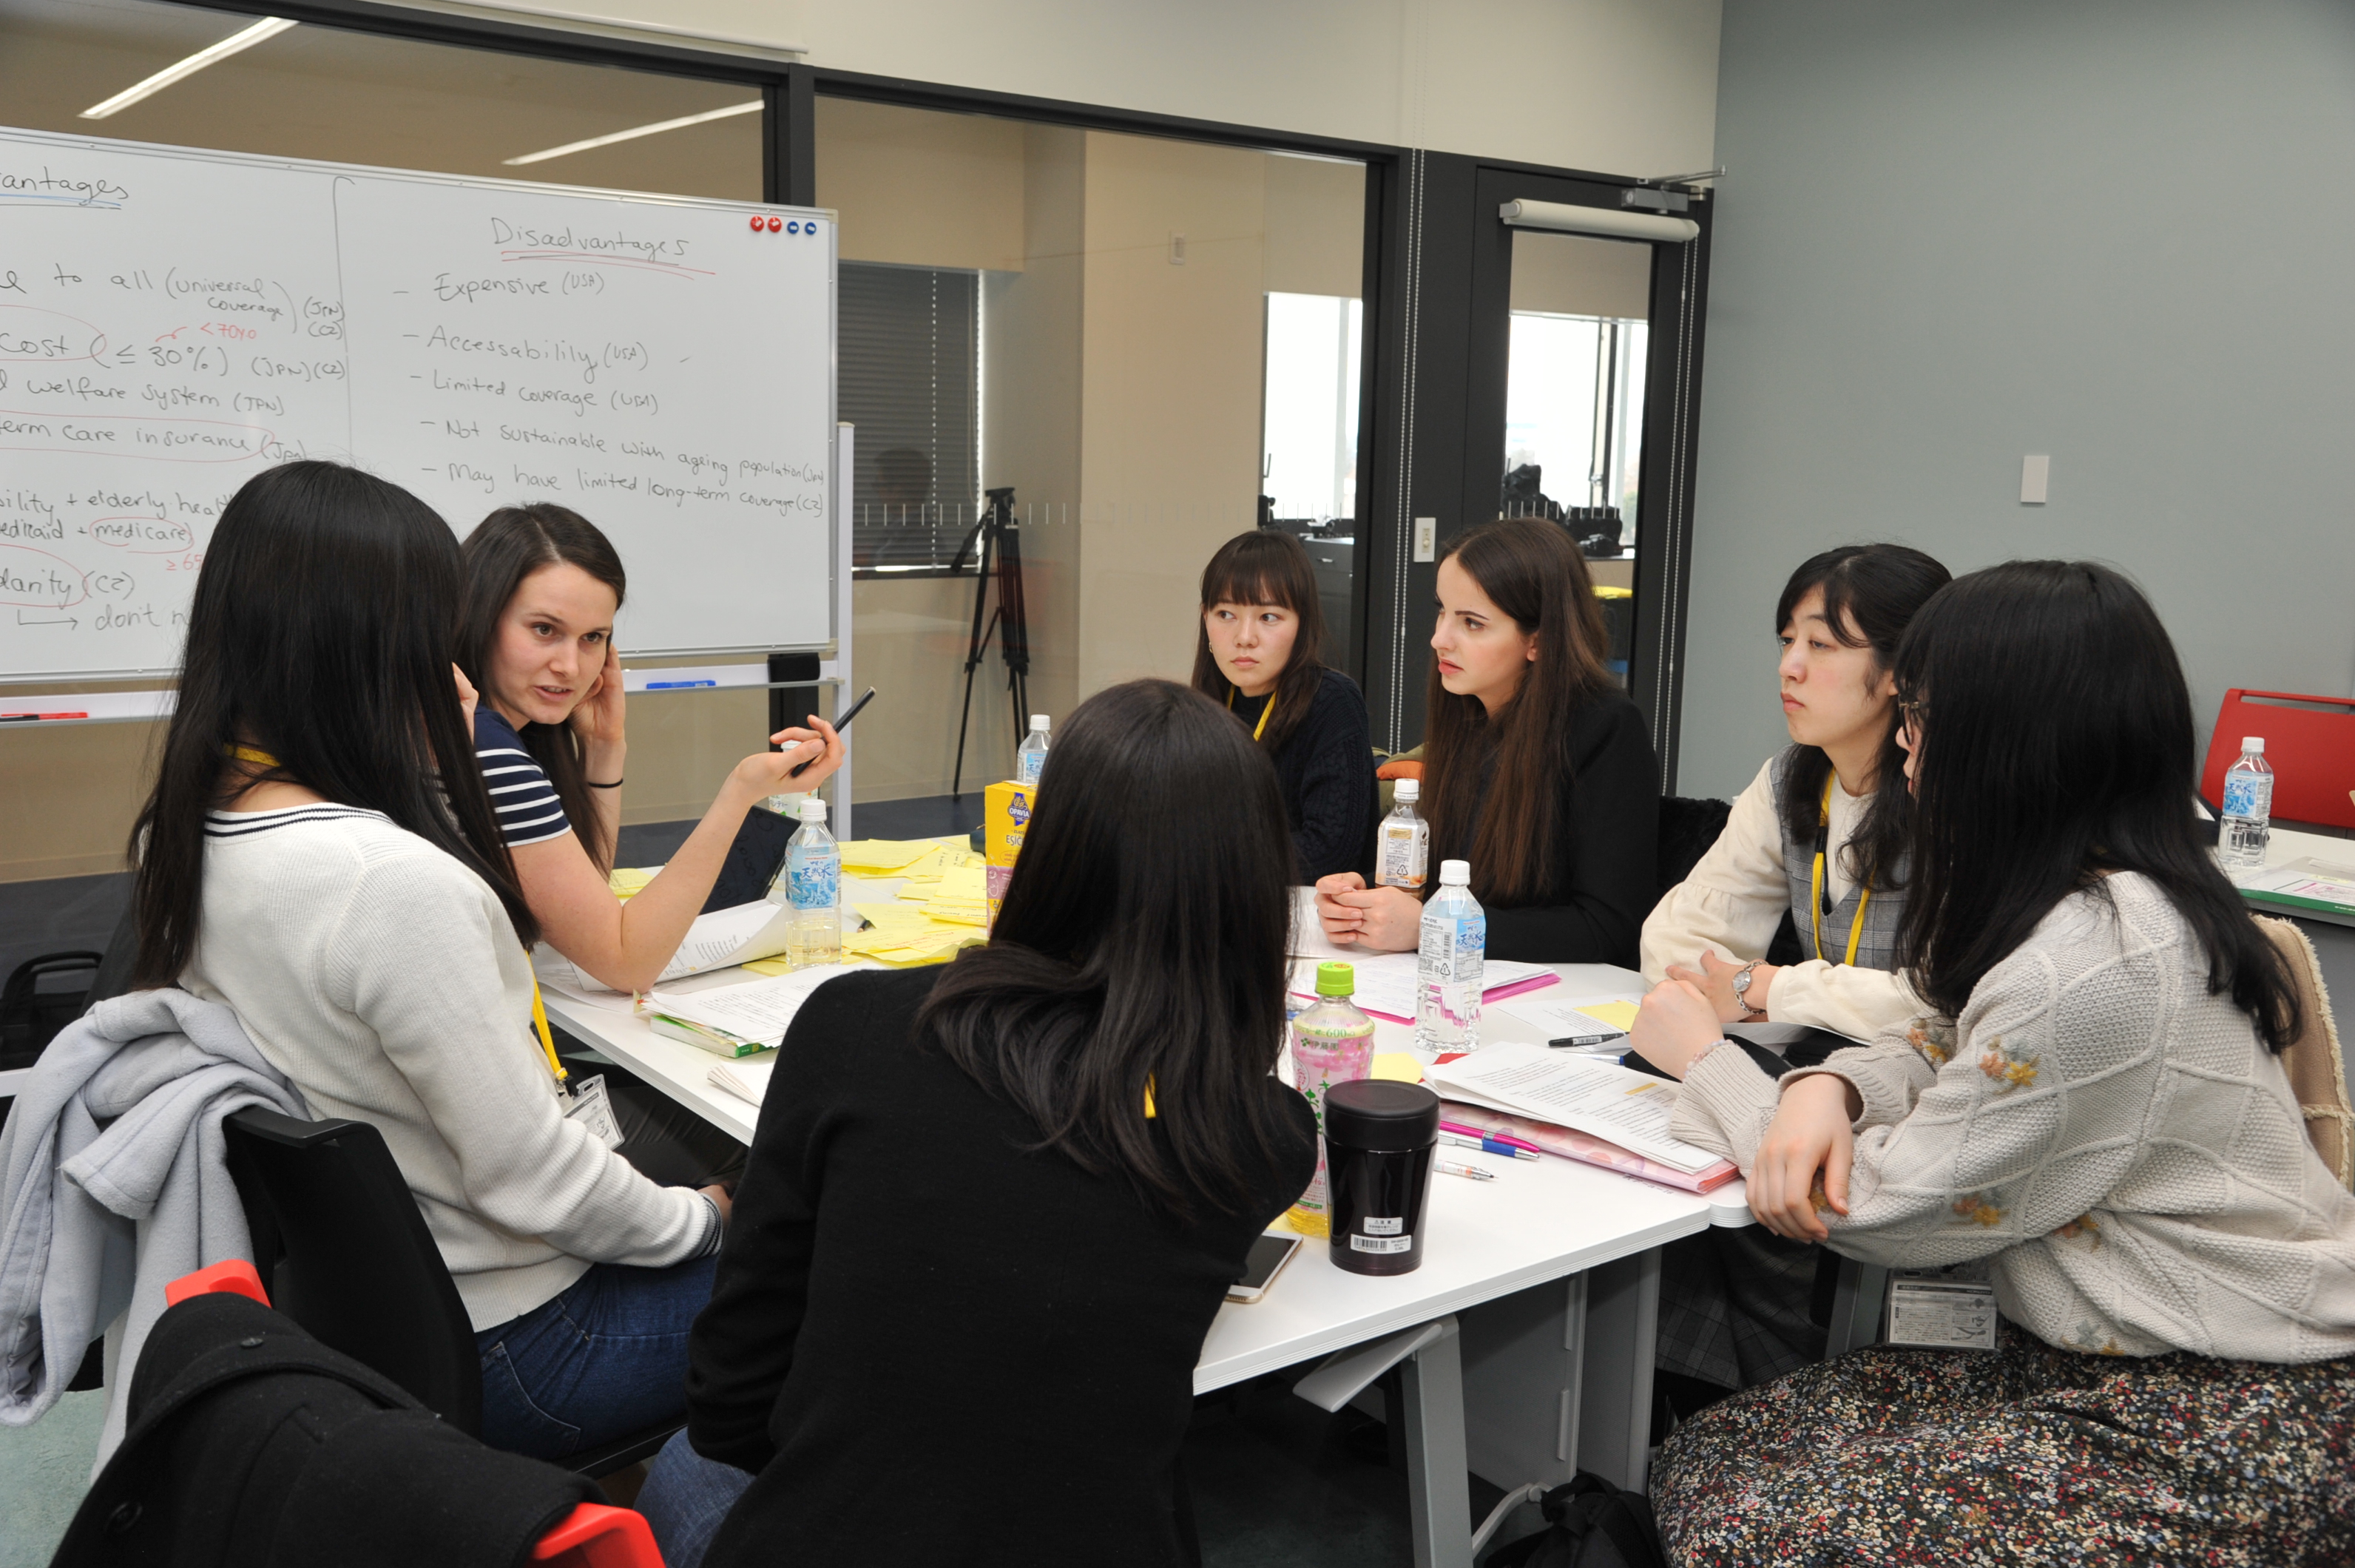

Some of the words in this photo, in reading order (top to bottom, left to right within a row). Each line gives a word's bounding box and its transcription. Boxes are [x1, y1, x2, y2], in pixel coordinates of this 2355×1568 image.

[0, 166, 129, 206] antages
[491, 217, 690, 263] Disadvantages
[54, 263, 82, 286] to
[110, 269, 153, 289] all
[433, 273, 550, 303] Expensive
[562, 271, 604, 295] (USA)
[604, 342, 648, 371] (USA)
[27, 376, 126, 401] welfare
[141, 384, 220, 410] system
[433, 369, 506, 396] Limited
[446, 419, 480, 439] Not
[678, 453, 728, 487] ageing
[449, 463, 494, 494] May
[514, 464, 561, 490] have
[577, 467, 638, 491] limited
[647, 477, 729, 508] long-term
[87, 490, 166, 520] elderly
[1009, 807, 1030, 818] OPAVIA
